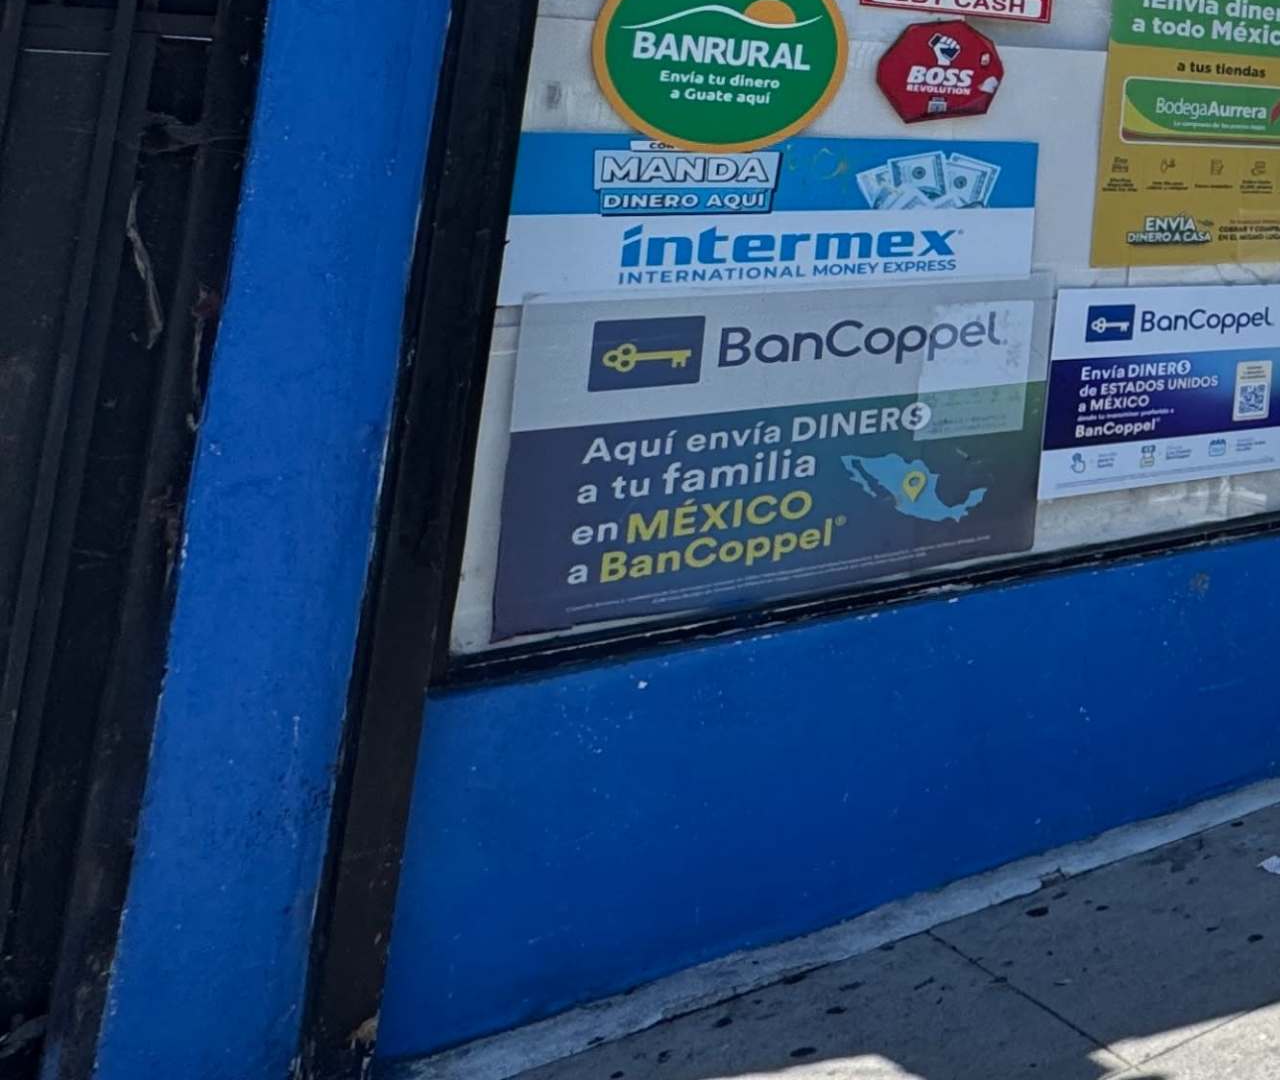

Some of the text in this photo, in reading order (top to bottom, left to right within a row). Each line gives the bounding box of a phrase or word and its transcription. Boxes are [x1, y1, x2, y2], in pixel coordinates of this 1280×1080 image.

[1132, 18, 1145, 33] a
[1152, 17, 1205, 39] todo
[632, 30, 811, 72] BANRURAL
[659, 70, 780, 89] Envía tu dinero
[906, 65, 974, 87] BOSS
[1177, 62, 1266, 78] a tus tiendas
[670, 87, 770, 106] a Guate aquí
[906, 84, 971, 95] REVOLUTION
[1156, 96, 1267, 120] BodegaAurrera
[600, 155, 770, 184] MANDA
[603, 189, 766, 210] DINERO AQUÍ
[620, 224, 958, 268] intermex
[618, 258, 957, 285] INTERNATIONAL MONEY EXPRESS
[1140, 307, 1272, 334] BanCoppel
[718, 311, 1003, 368] BanCoppel
[1081, 364, 1125, 381] Envía
[1079, 375, 1219, 397] de ESTADOS UNIDOS
[1078, 393, 1151, 413] a MÉXICO
[582, 430, 676, 467] Aquí
[686, 419, 782, 453] envía
[577, 450, 818, 506] a tu familia
[572, 490, 813, 546] en MÉXICO
[567, 562, 588, 586] a
